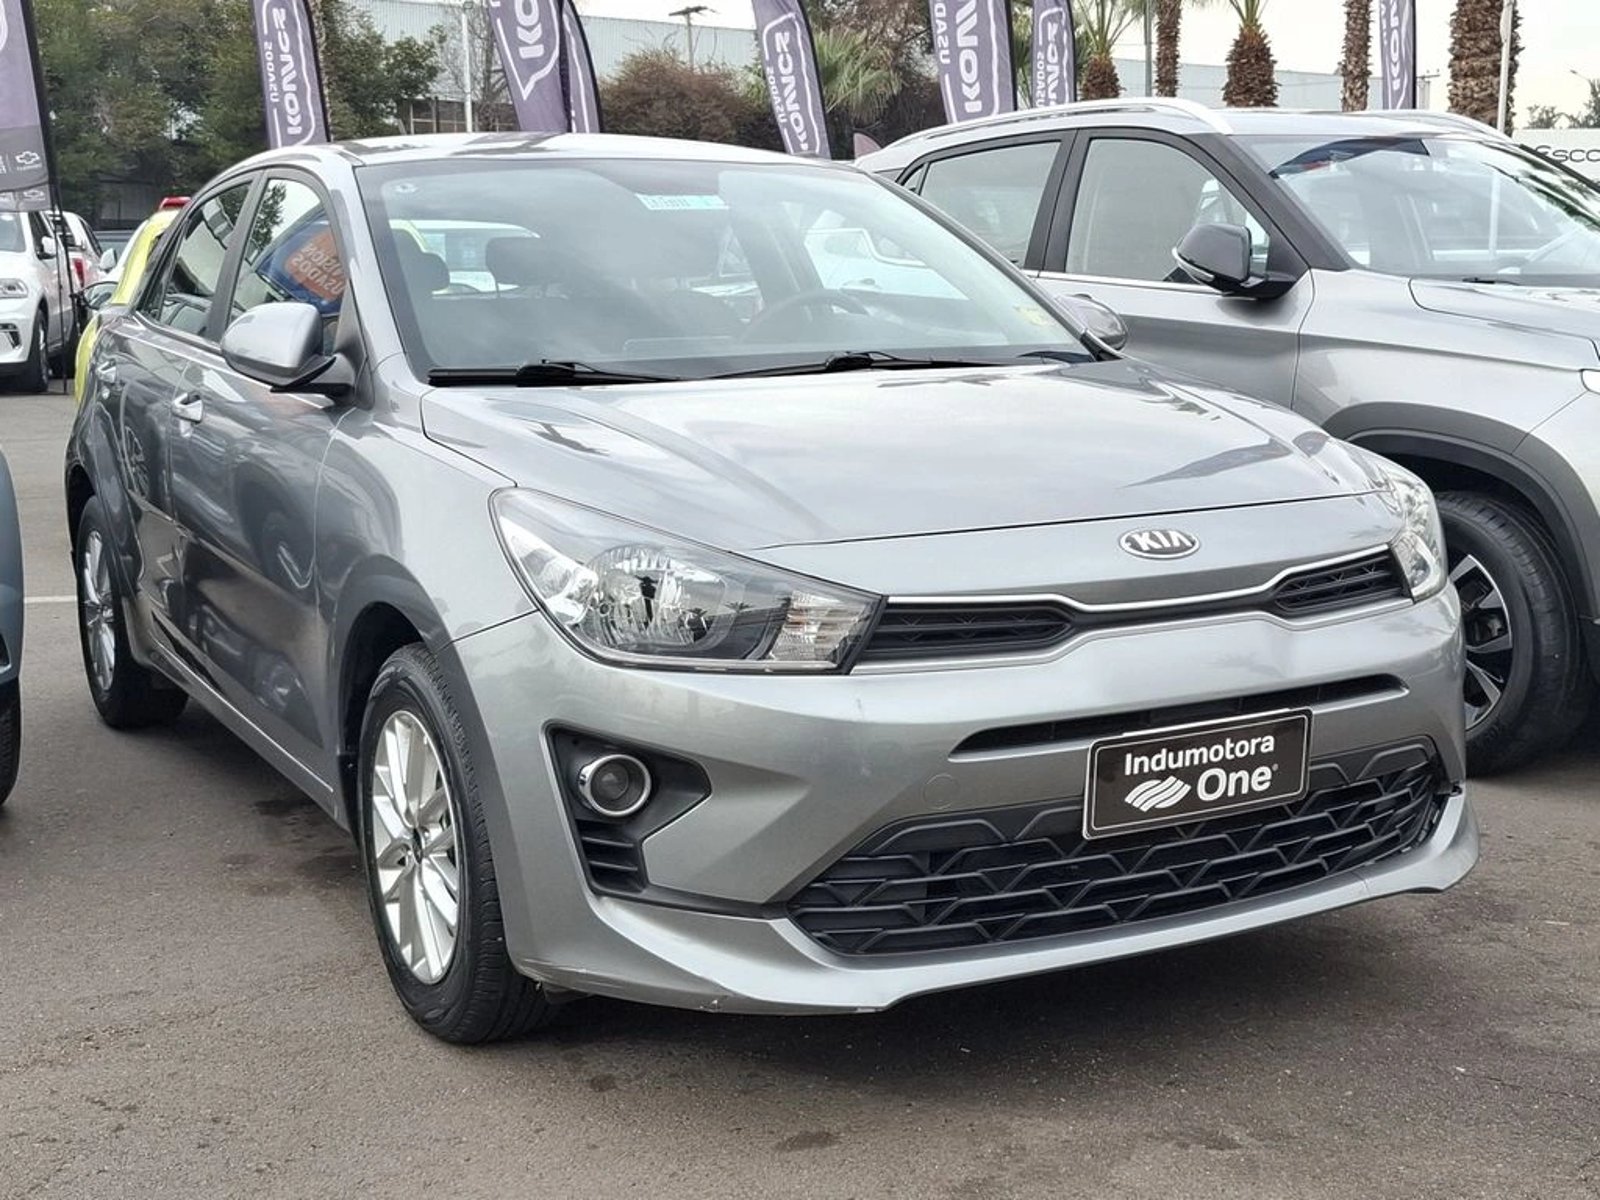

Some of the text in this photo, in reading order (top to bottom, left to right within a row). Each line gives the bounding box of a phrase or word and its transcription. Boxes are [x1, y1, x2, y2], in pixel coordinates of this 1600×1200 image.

[1131, 530, 1192, 551] KIA
[1124, 735, 1275, 776] Indumotora
[1197, 765, 1273, 801] One
